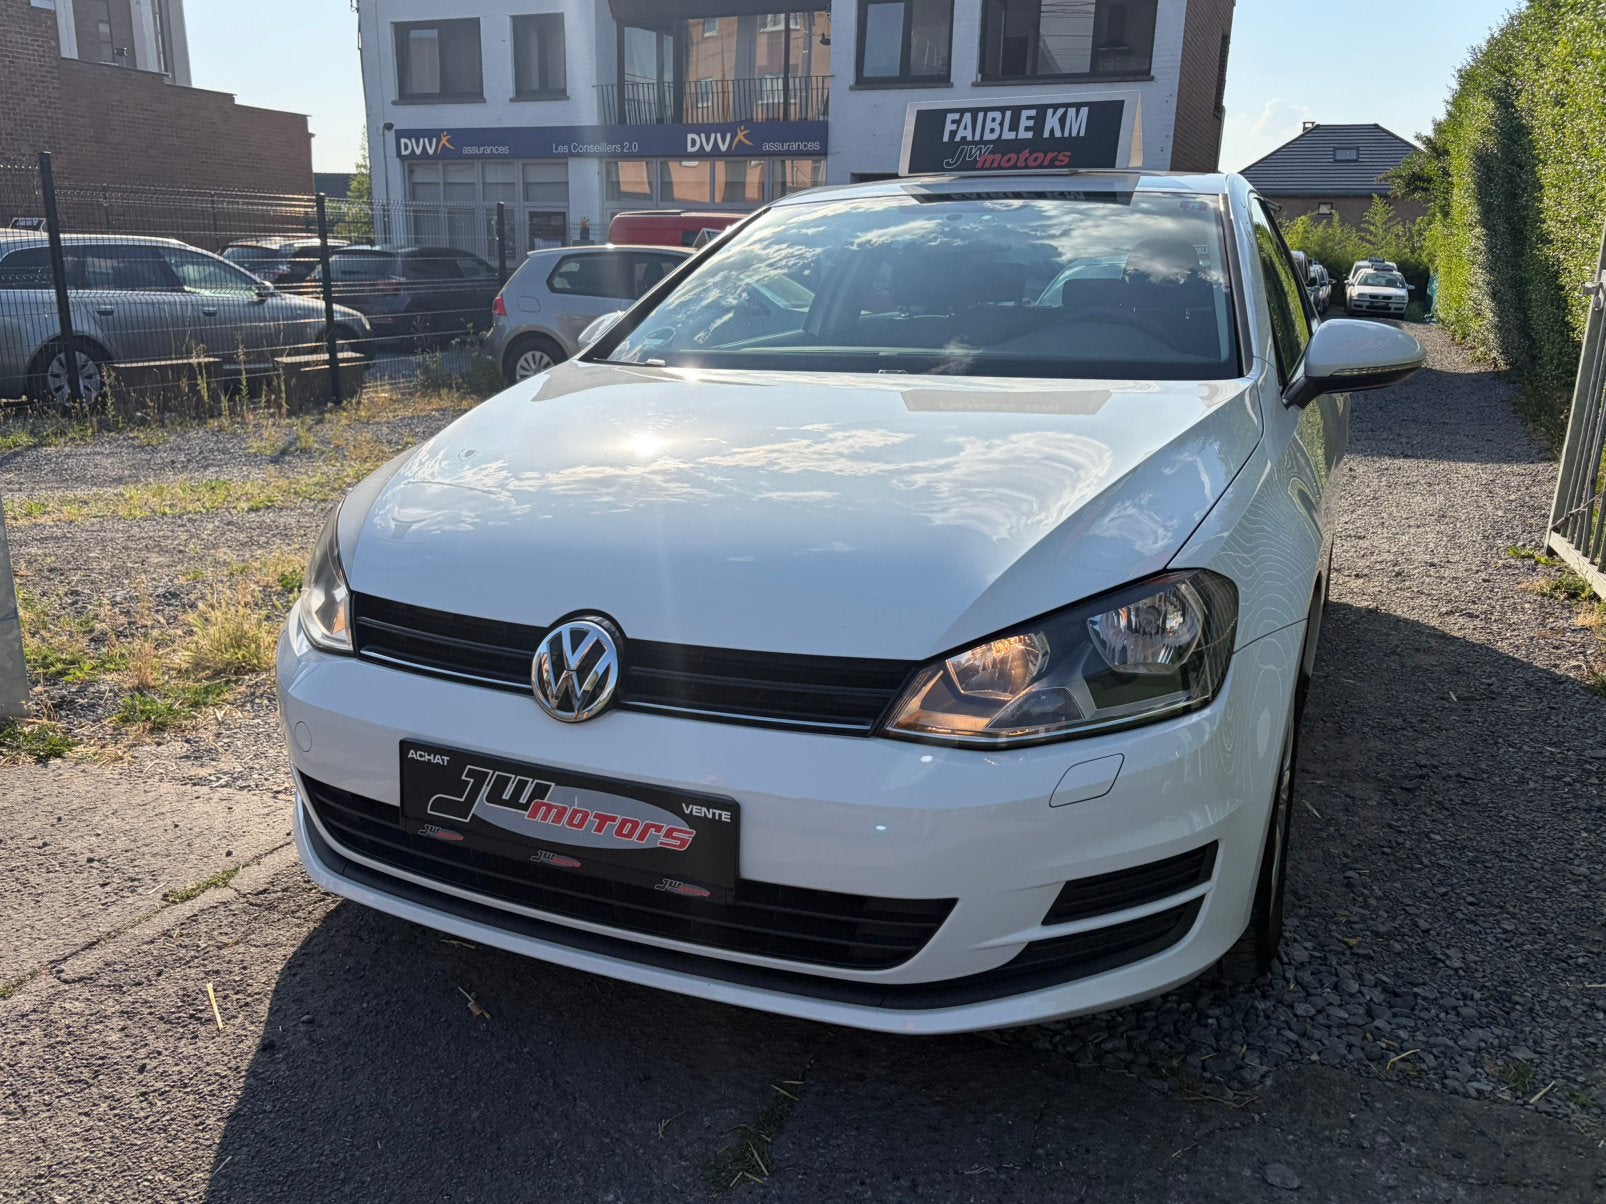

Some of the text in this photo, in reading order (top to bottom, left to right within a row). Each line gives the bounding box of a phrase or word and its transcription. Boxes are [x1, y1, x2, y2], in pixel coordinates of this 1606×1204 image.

[942, 106, 1089, 142] FAIBLE KM
[400, 137, 509, 156] DVV assurances
[552, 142, 639, 154] Les Conseillers 2.0
[686, 132, 820, 153] DVV assurances
[943, 144, 1072, 169] JW motors
[407, 749, 450, 766] ACHAT
[427, 764, 556, 823] JW
[681, 802, 732, 823] VENTE
